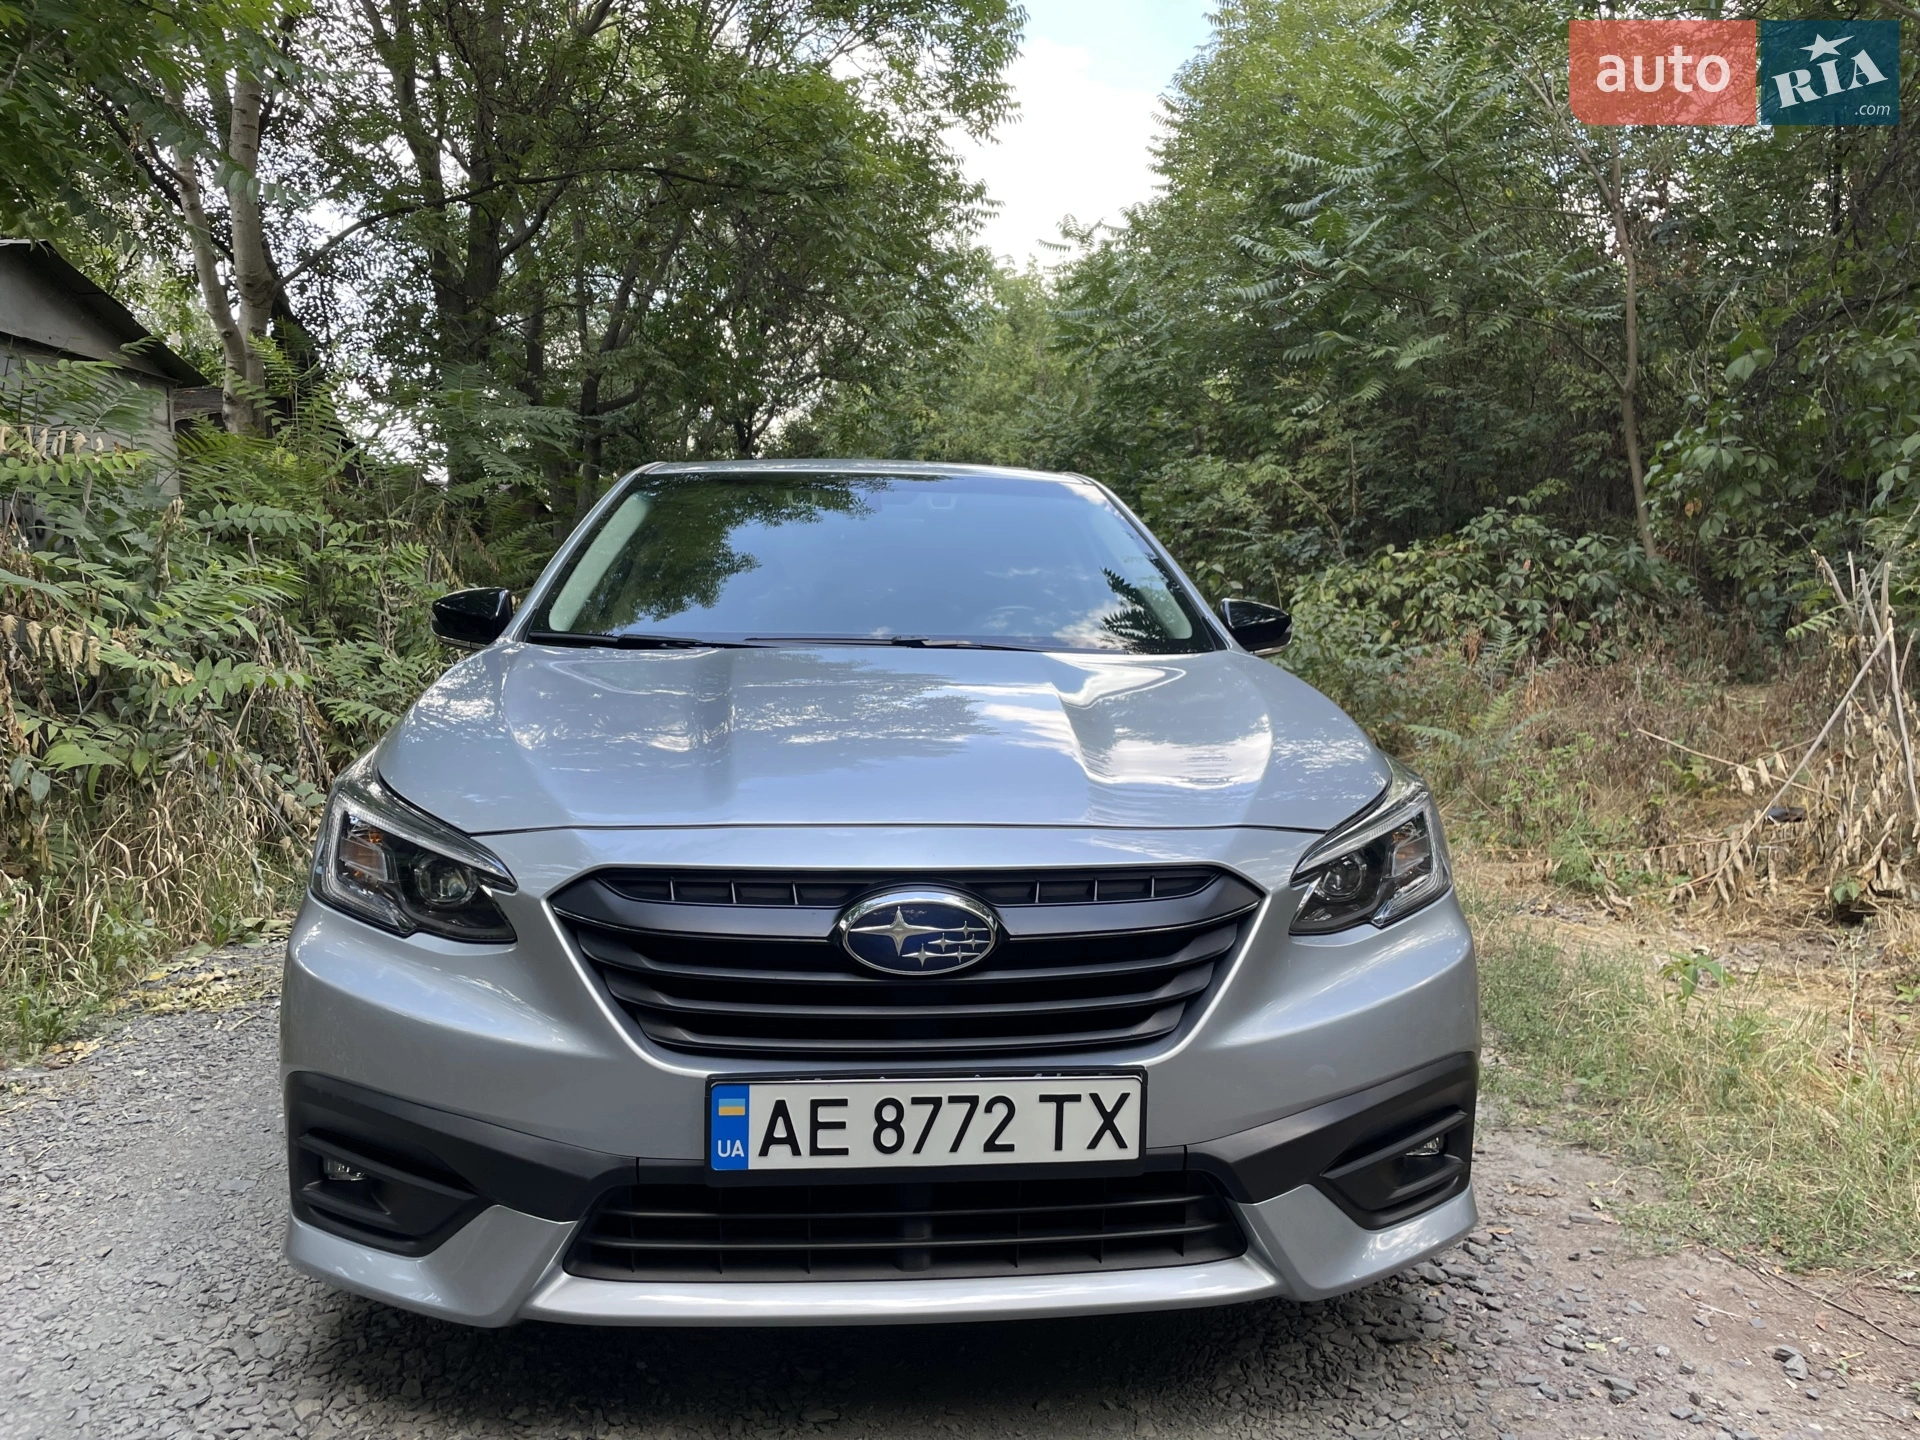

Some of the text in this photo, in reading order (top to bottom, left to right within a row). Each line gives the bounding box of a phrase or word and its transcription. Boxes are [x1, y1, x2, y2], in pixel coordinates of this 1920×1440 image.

[758, 1092, 1131, 1157] AE 8772 TX
[717, 1140, 745, 1158] UA
